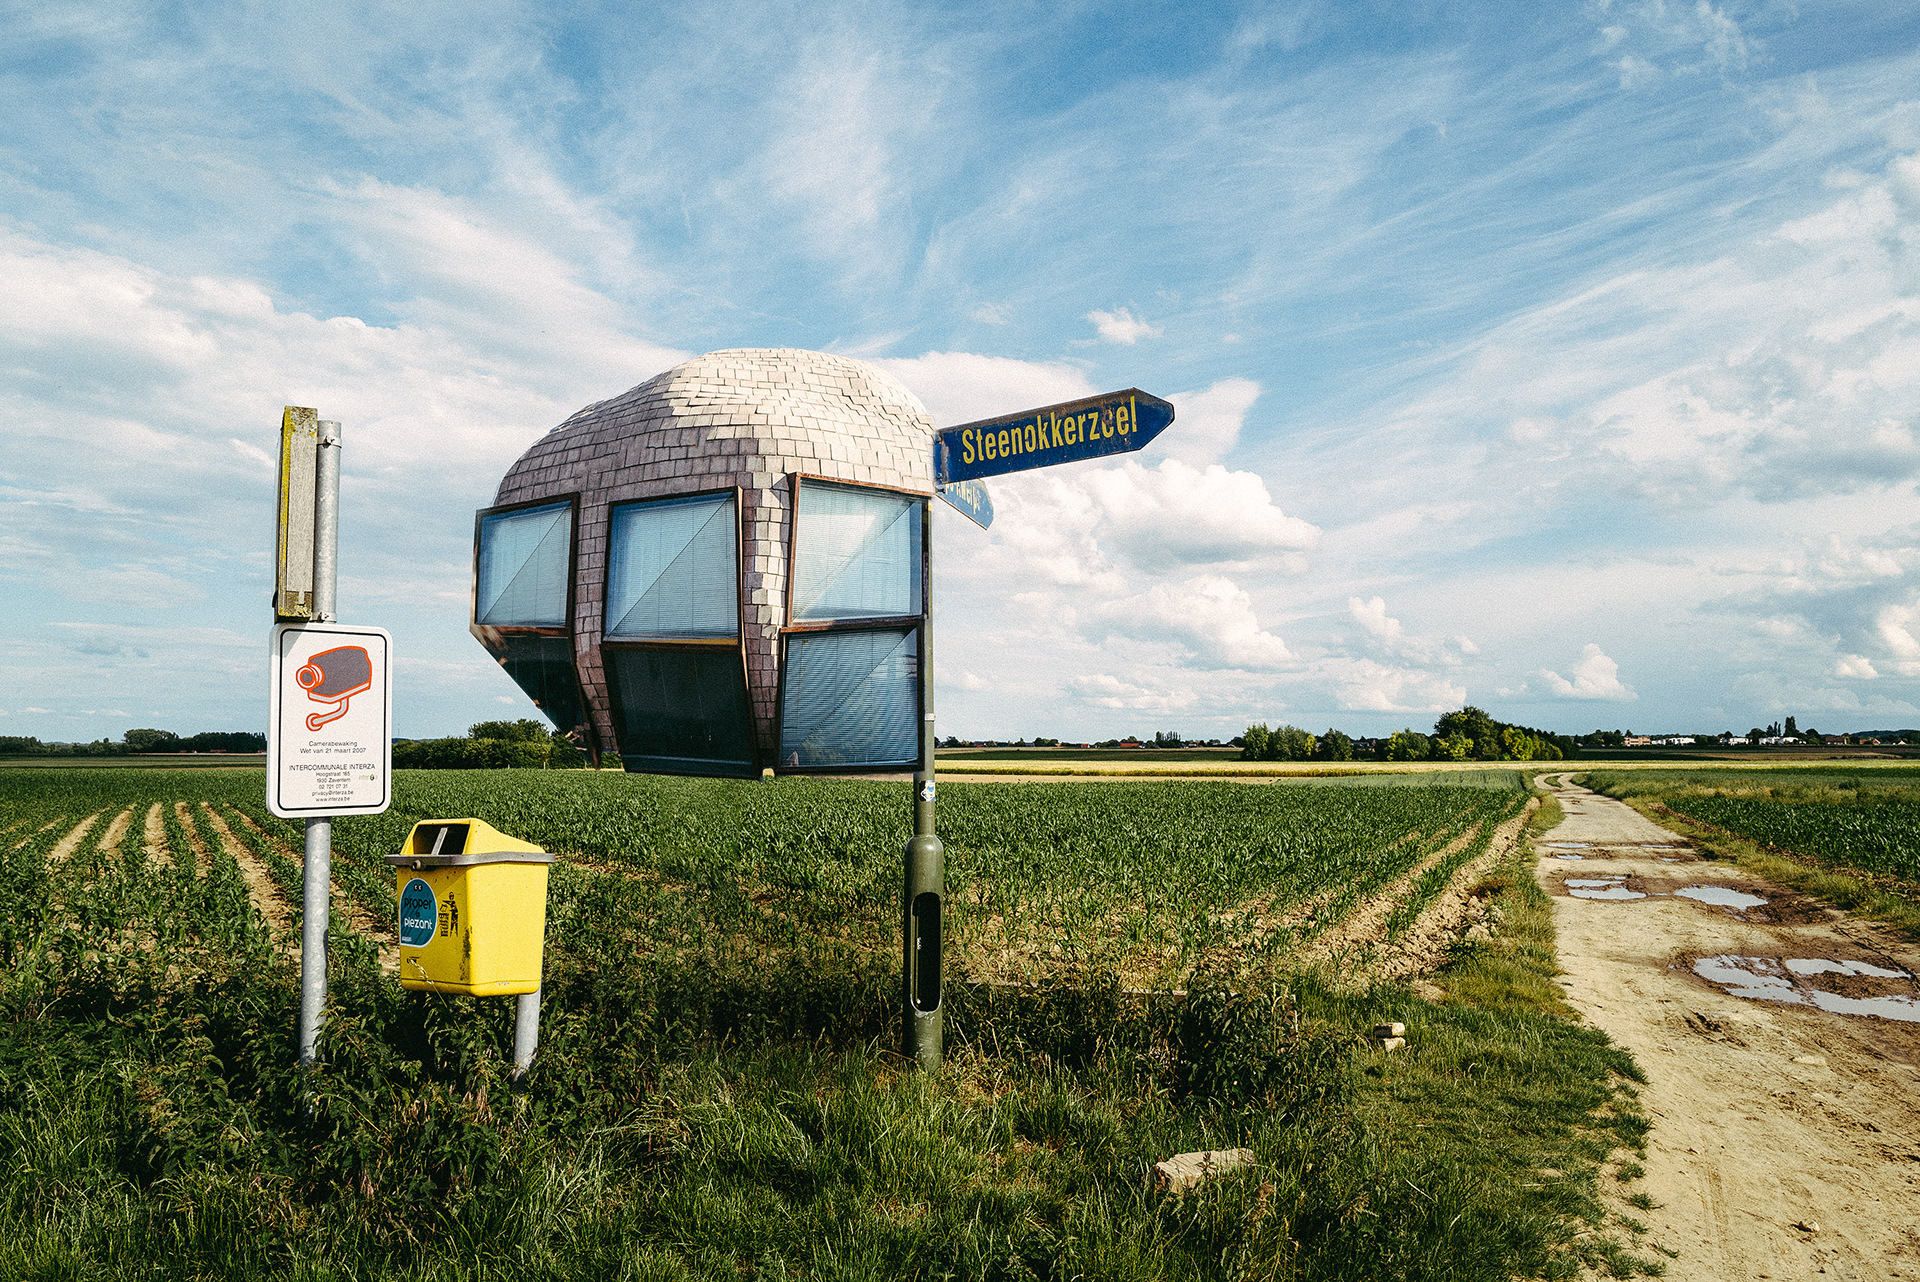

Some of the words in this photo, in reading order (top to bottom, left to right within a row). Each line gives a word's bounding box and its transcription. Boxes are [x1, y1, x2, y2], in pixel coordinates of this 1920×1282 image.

[961, 395, 1138, 464] Steenokkerzeel
[308, 740, 358, 748] Camerabewaking
[404, 898, 432, 910] proper
